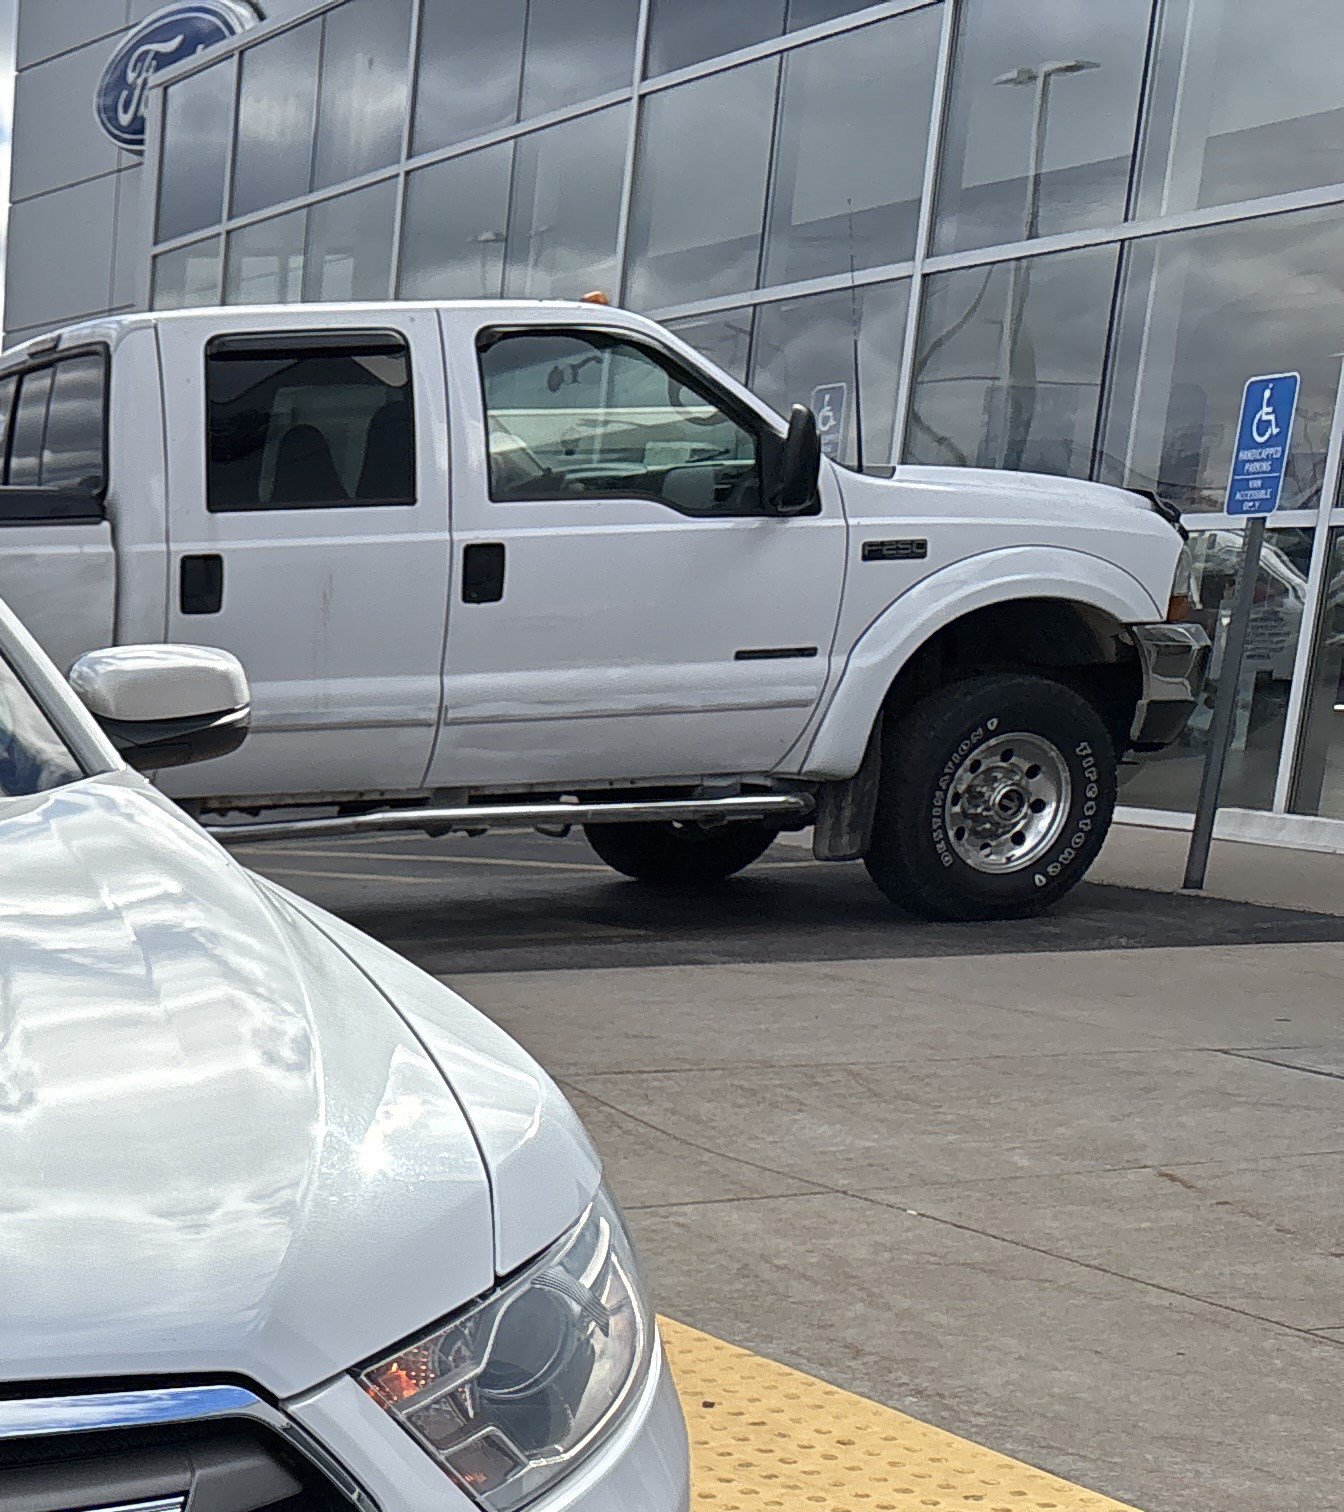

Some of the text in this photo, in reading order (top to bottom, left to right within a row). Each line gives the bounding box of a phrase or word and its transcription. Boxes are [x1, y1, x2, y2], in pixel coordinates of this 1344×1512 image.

[1238, 447, 1282, 461] HANDICAPPED
[1243, 461, 1272, 474] PARKING
[1234, 488, 1272, 501] ACCESSIBLE
